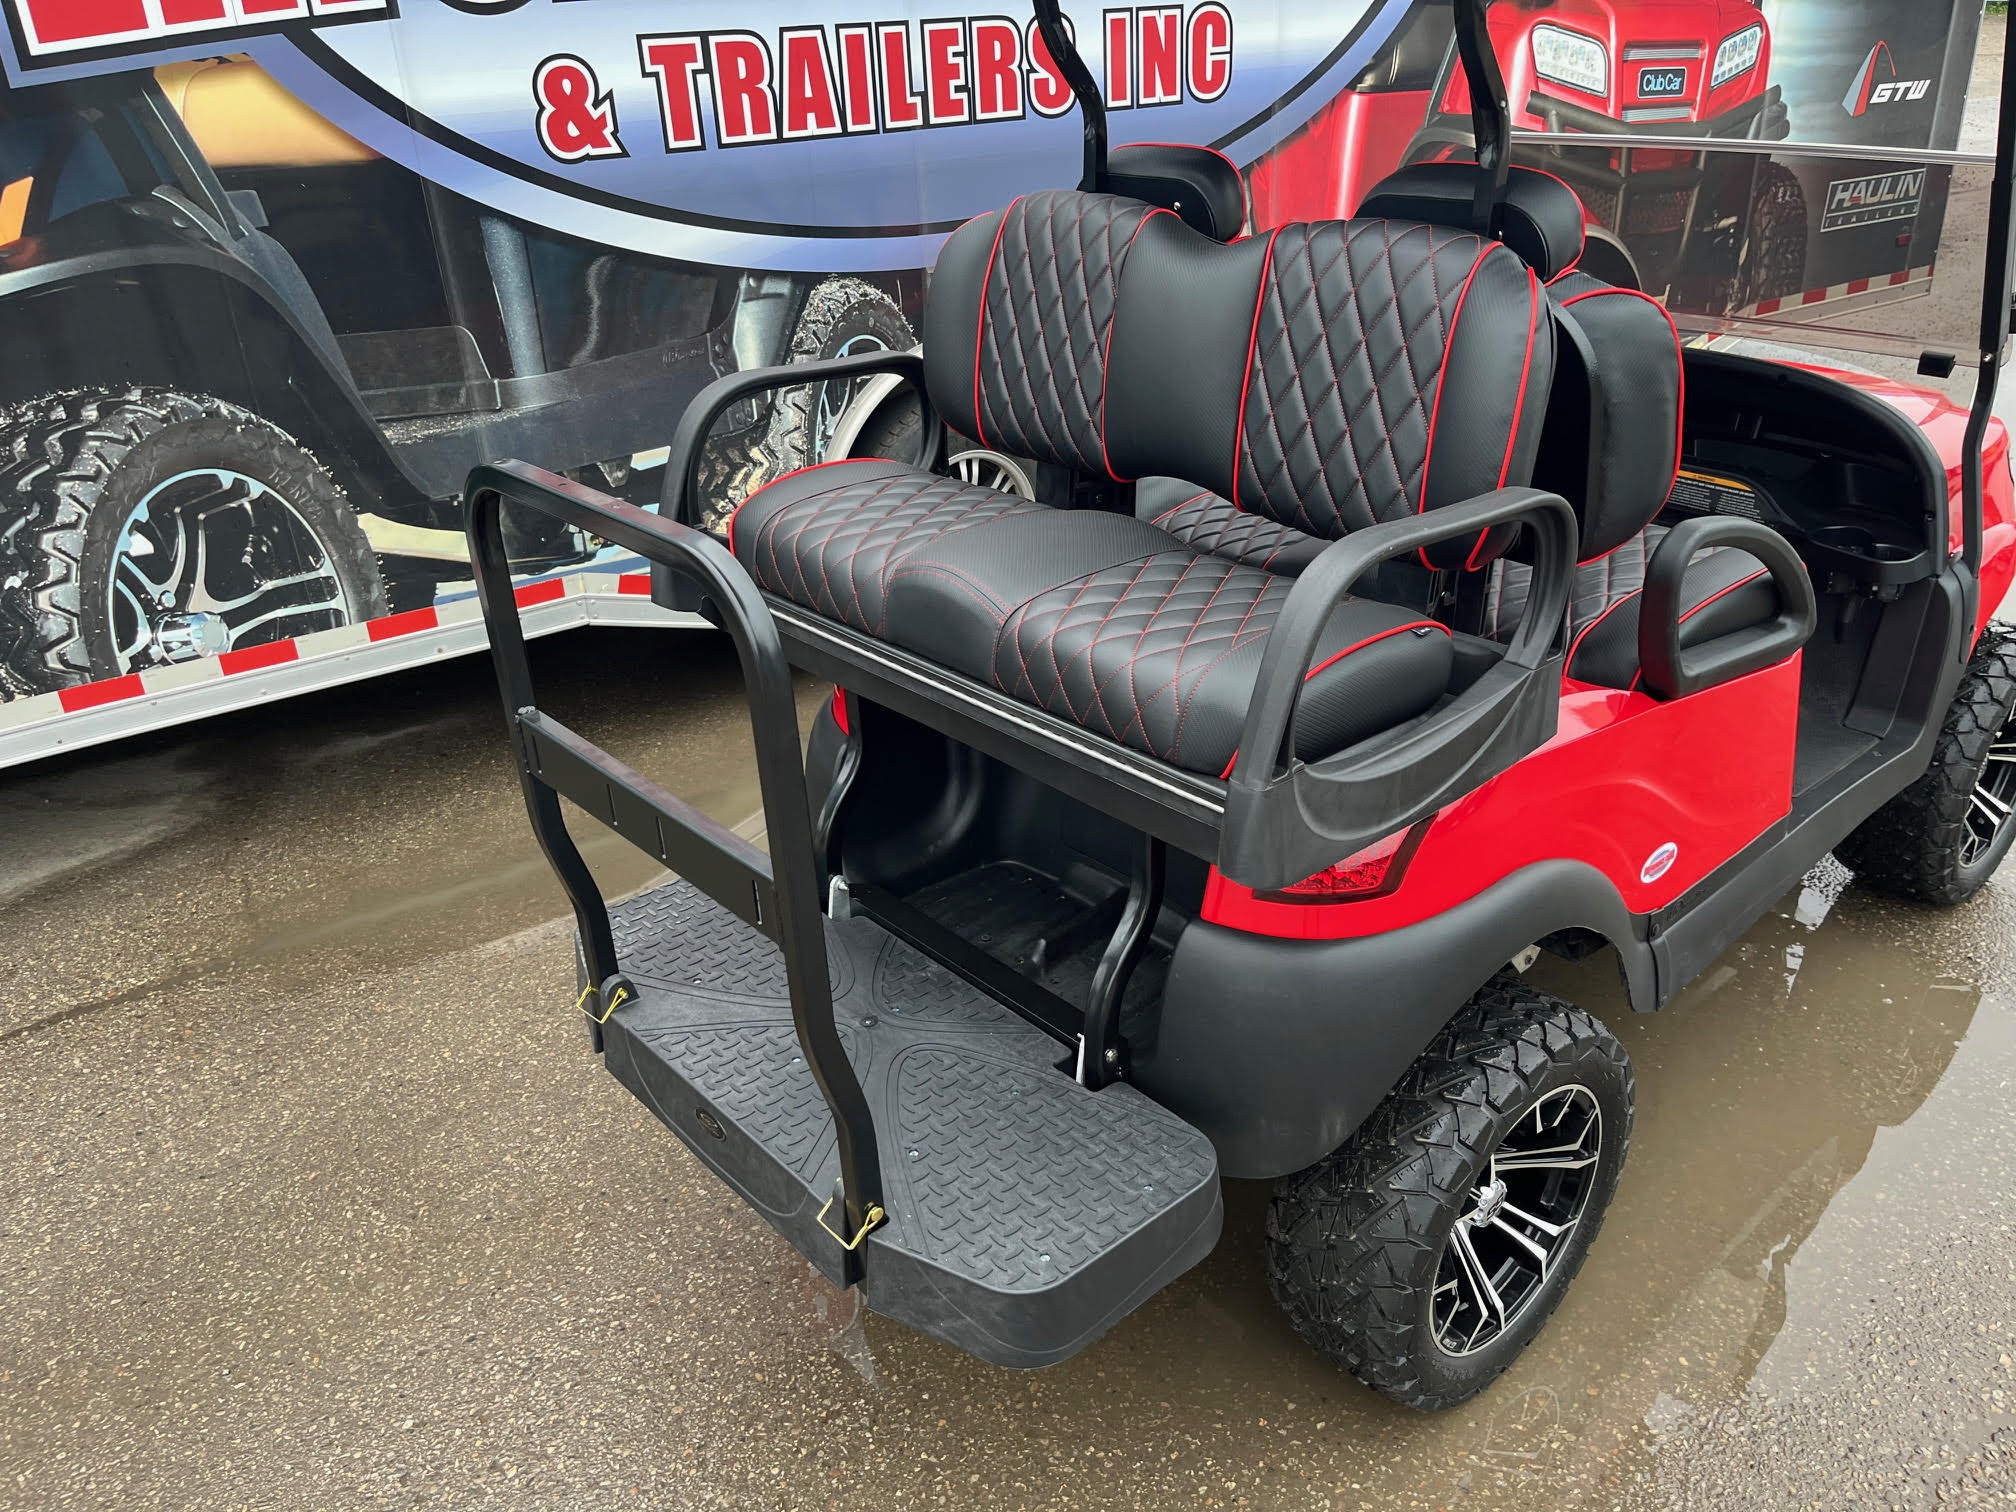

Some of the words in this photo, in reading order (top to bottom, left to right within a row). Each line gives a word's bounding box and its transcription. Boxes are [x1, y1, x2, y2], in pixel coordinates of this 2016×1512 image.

[533, 53, 631, 164] &
[636, 12, 1076, 153] TRAILERS
[1103, 1, 1233, 111] INC
[1643, 74, 1665, 92] Club
[1665, 73, 1682, 90] Car
[1869, 79, 1931, 104] GTW
[1830, 172, 1923, 210] HAULIN
